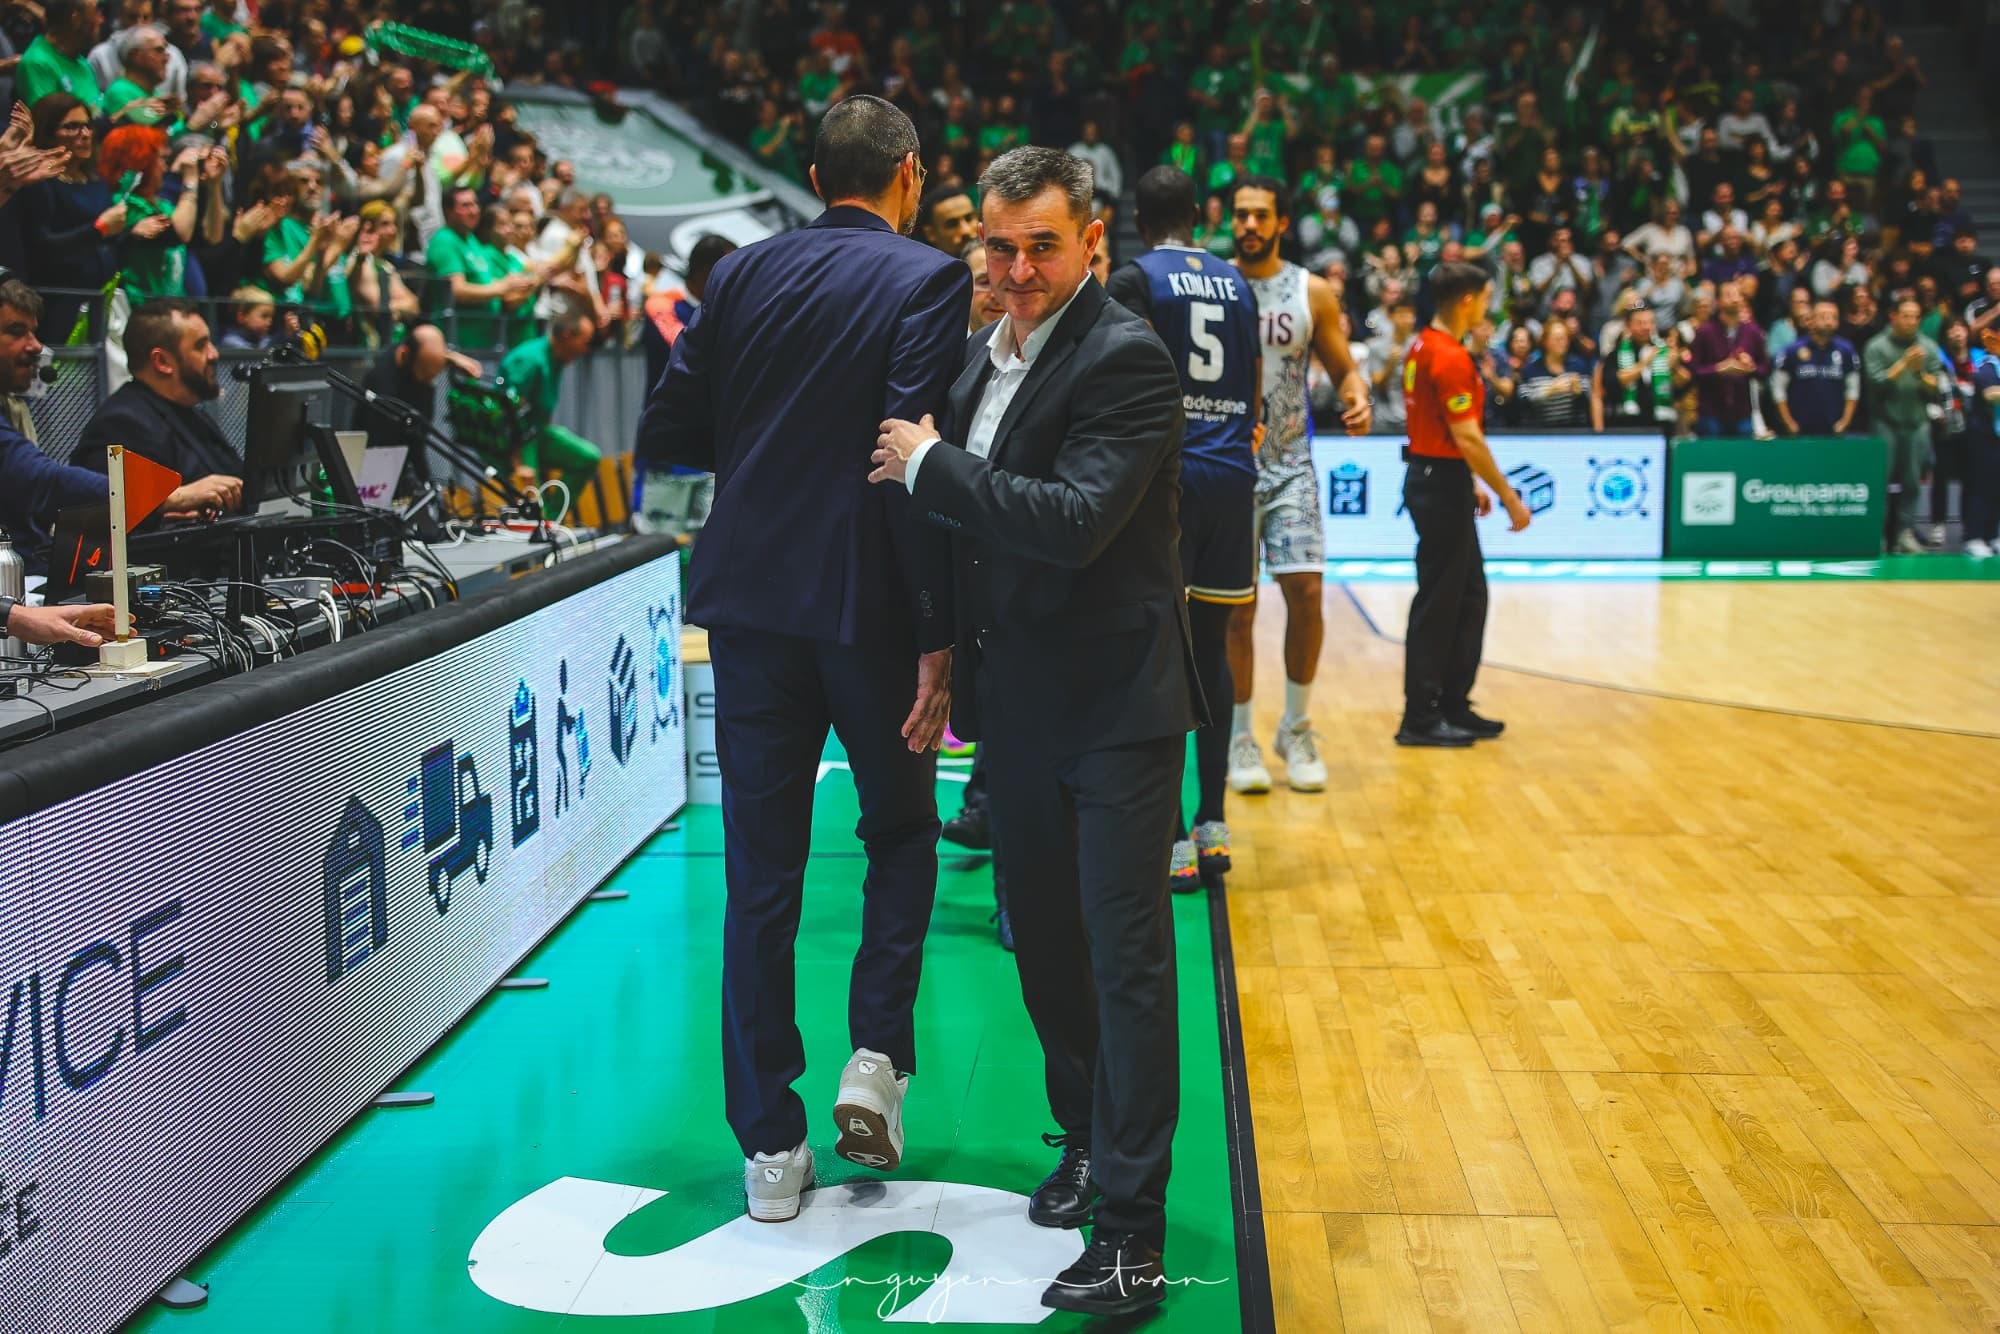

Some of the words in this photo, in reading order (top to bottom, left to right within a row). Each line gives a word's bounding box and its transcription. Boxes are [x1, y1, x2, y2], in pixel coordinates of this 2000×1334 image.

[1168, 272, 1239, 301] KONATE
[1188, 301, 1225, 382] 5
[1743, 479, 1869, 507] Groupama
